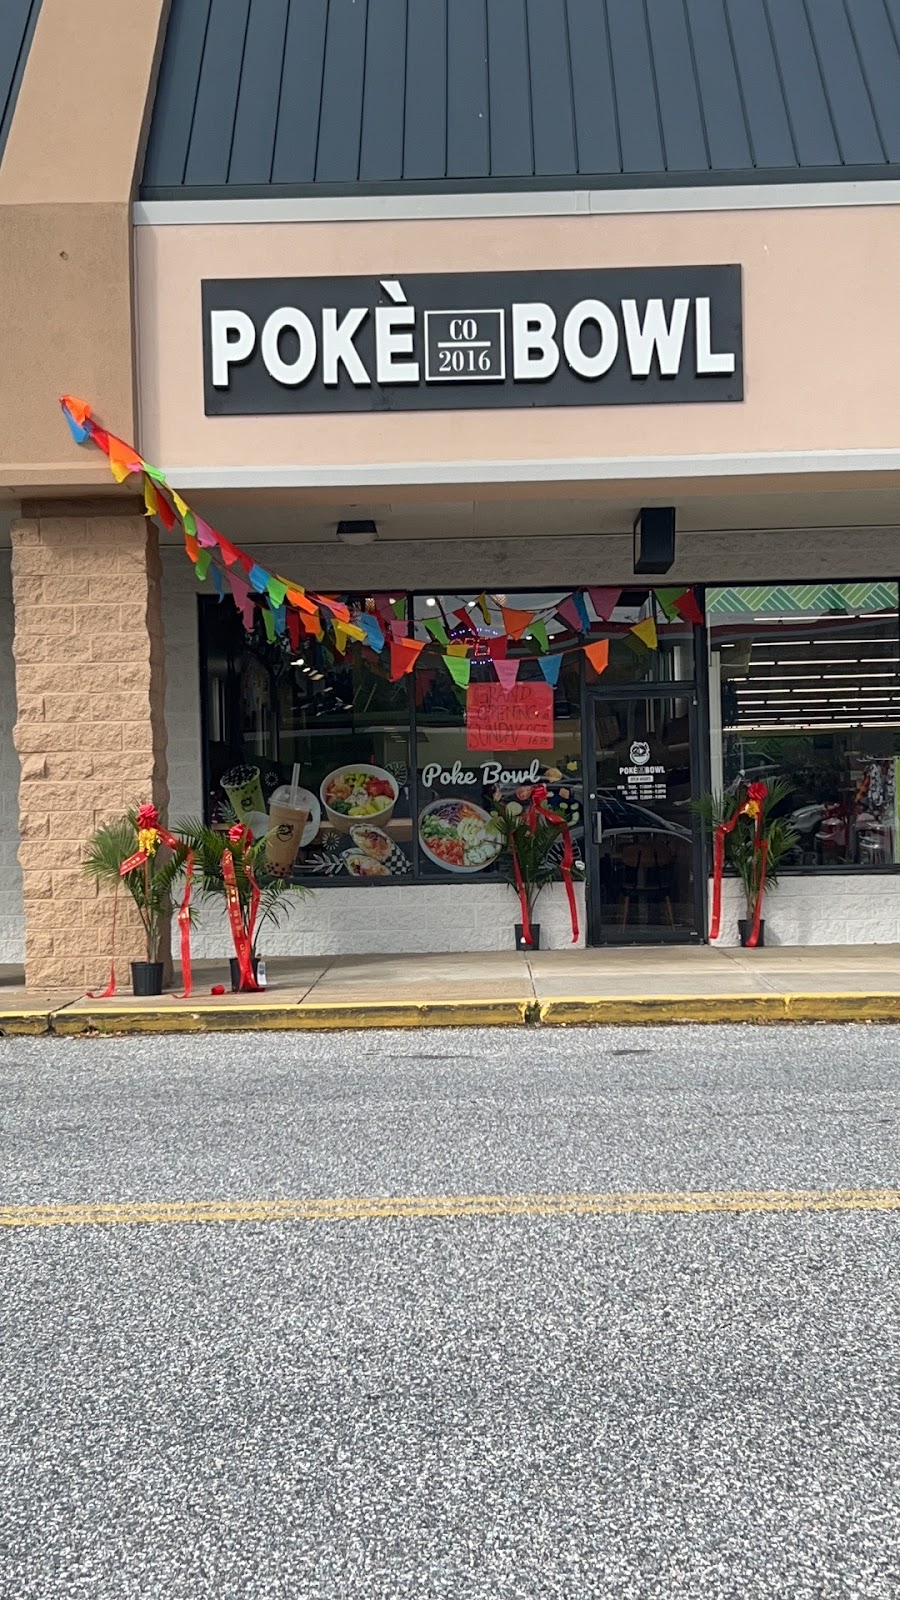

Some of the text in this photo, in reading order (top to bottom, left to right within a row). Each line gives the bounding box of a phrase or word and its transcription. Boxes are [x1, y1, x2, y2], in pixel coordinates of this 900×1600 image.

[210, 280, 735, 387] POKÈ BOWL
[449, 319, 477, 340] CO
[438, 349, 491, 372] 2016
[475, 685, 532, 704] GRAND
[421, 759, 540, 788] Poke Bowl
[645, 766, 665, 774] BOWL
